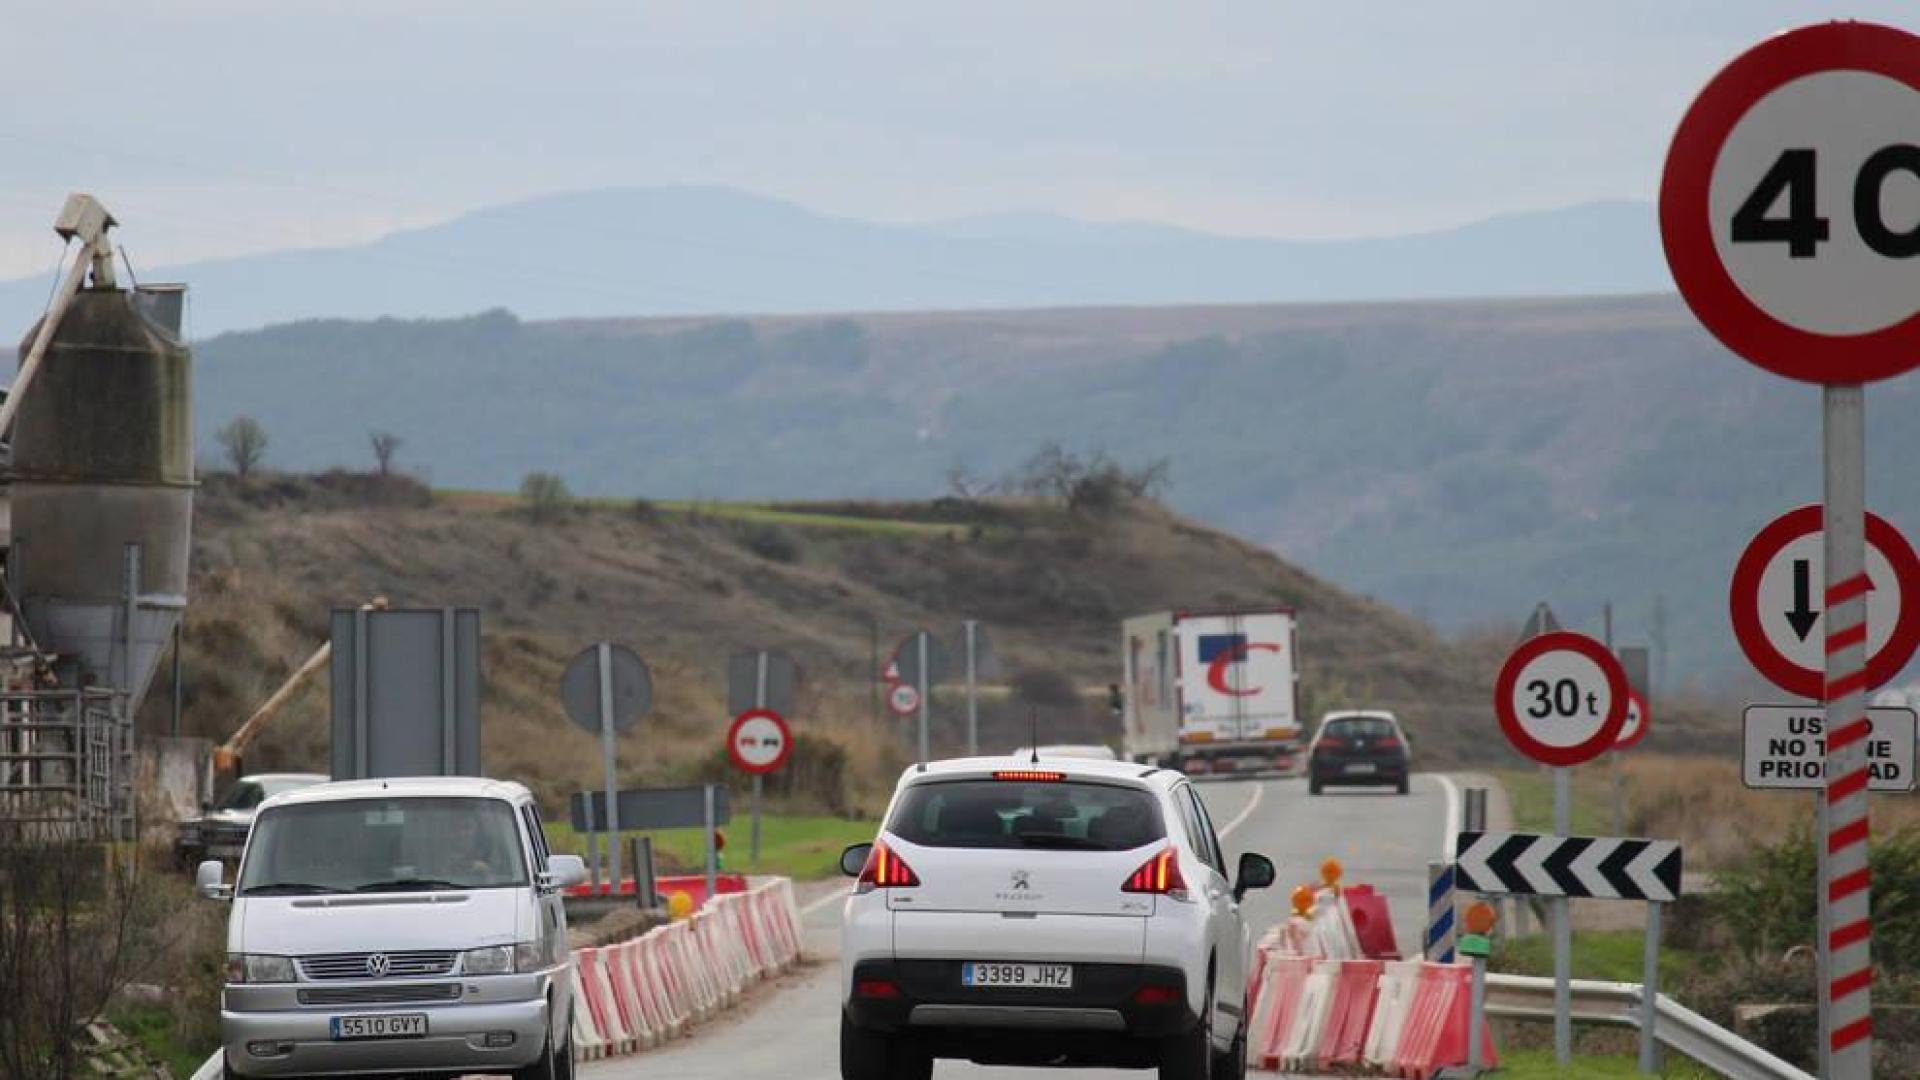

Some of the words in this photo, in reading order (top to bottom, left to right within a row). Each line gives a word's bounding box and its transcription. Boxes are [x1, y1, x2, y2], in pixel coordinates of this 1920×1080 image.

[1731, 143, 1920, 259] 40
[1527, 678, 1579, 718] 30
[1586, 691, 1598, 716] t
[1769, 738, 1806, 757] NO
[1760, 761, 1900, 780] PRIOAD
[976, 965, 1025, 984] 3399
[1032, 966, 1069, 985] JHZ
[343, 1018, 385, 1035] 5510
